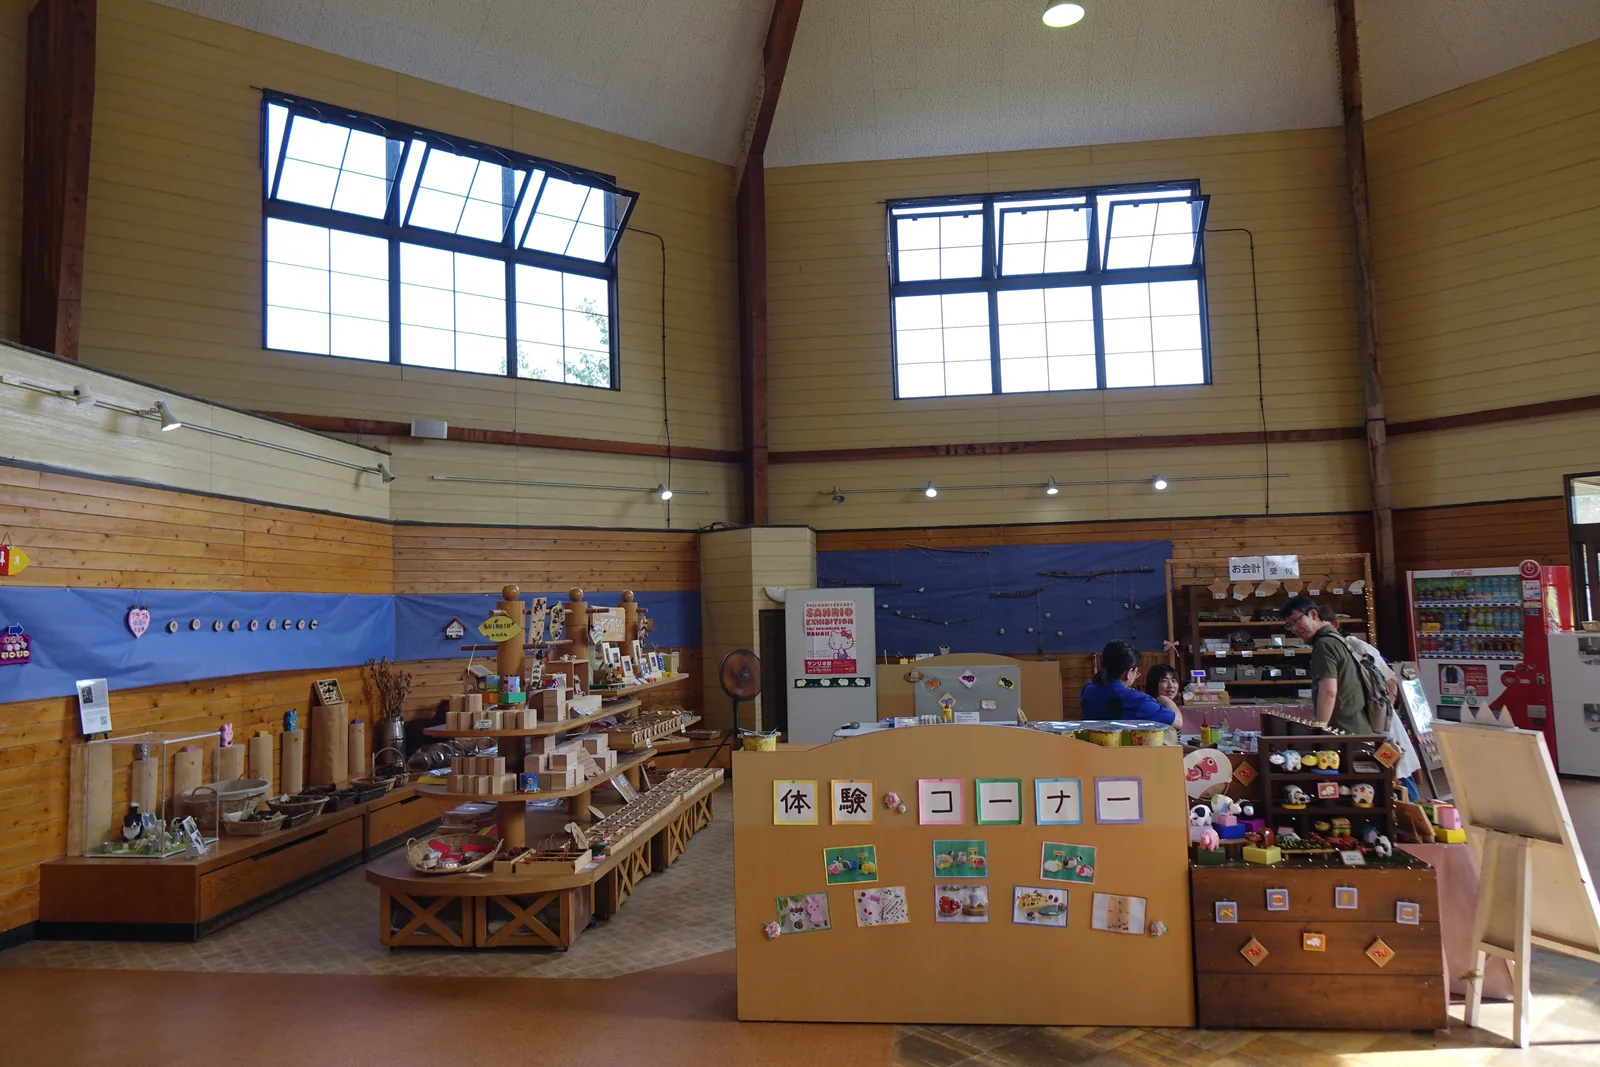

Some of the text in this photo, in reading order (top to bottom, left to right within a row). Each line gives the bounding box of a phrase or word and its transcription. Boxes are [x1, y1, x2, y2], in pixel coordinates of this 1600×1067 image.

[1232, 564, 1261, 574] お会計
[1269, 567, 1293, 575] 受付
[806, 608, 853, 618] SANRIO
